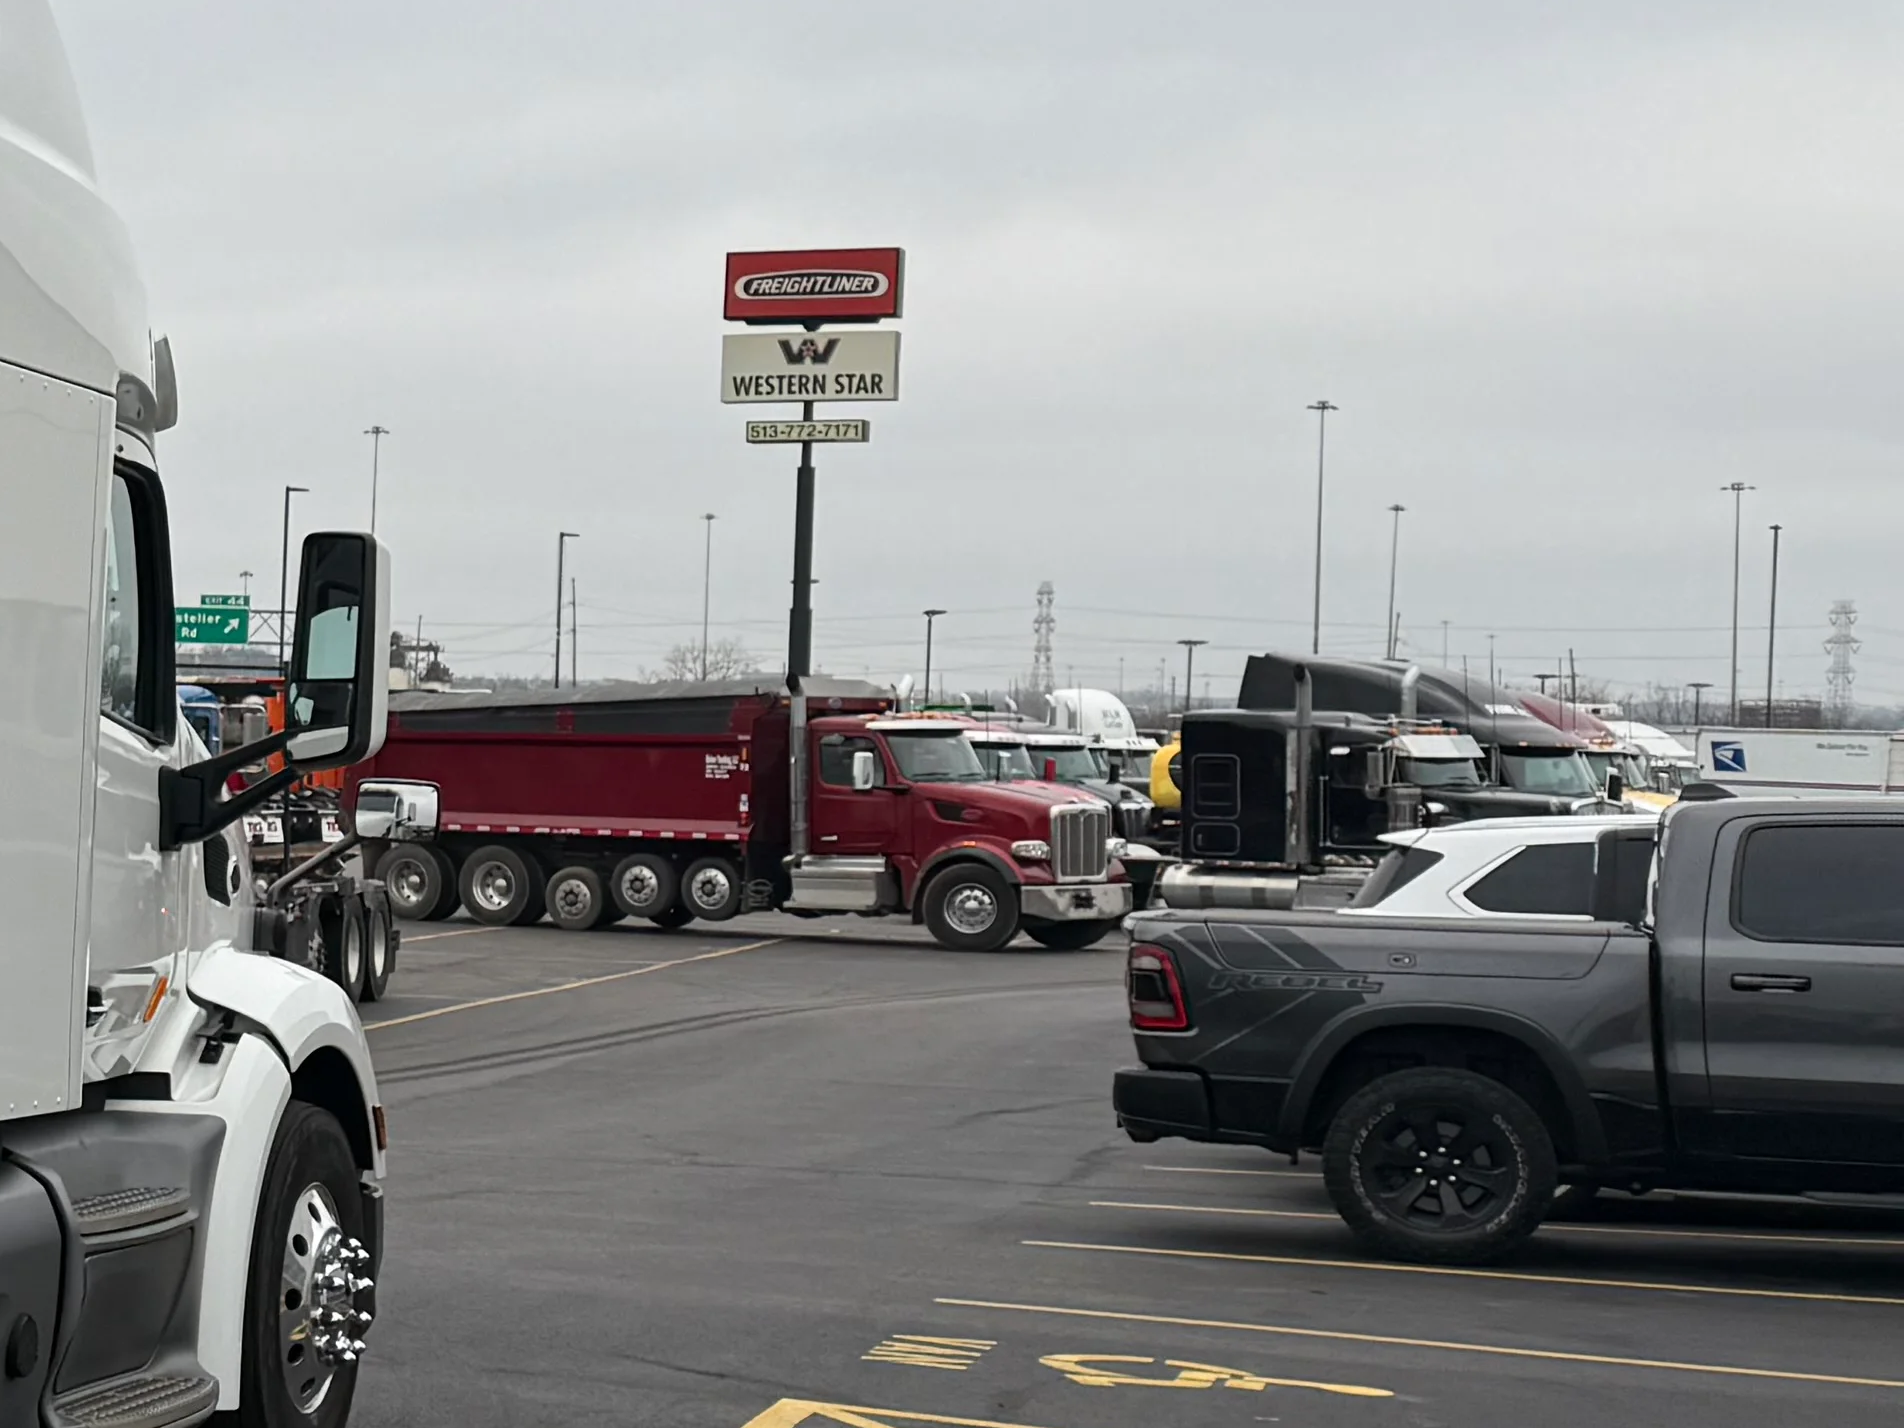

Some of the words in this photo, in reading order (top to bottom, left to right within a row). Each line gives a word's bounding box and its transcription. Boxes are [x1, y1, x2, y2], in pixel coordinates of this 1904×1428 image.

[748, 274, 876, 296] FREIGHTLINER
[732, 374, 827, 397] WESTERN
[834, 373, 884, 396] STAR
[749, 422, 861, 440] 513-772-7171
[227, 596, 245, 605] 44
[181, 626, 198, 639] Rd
